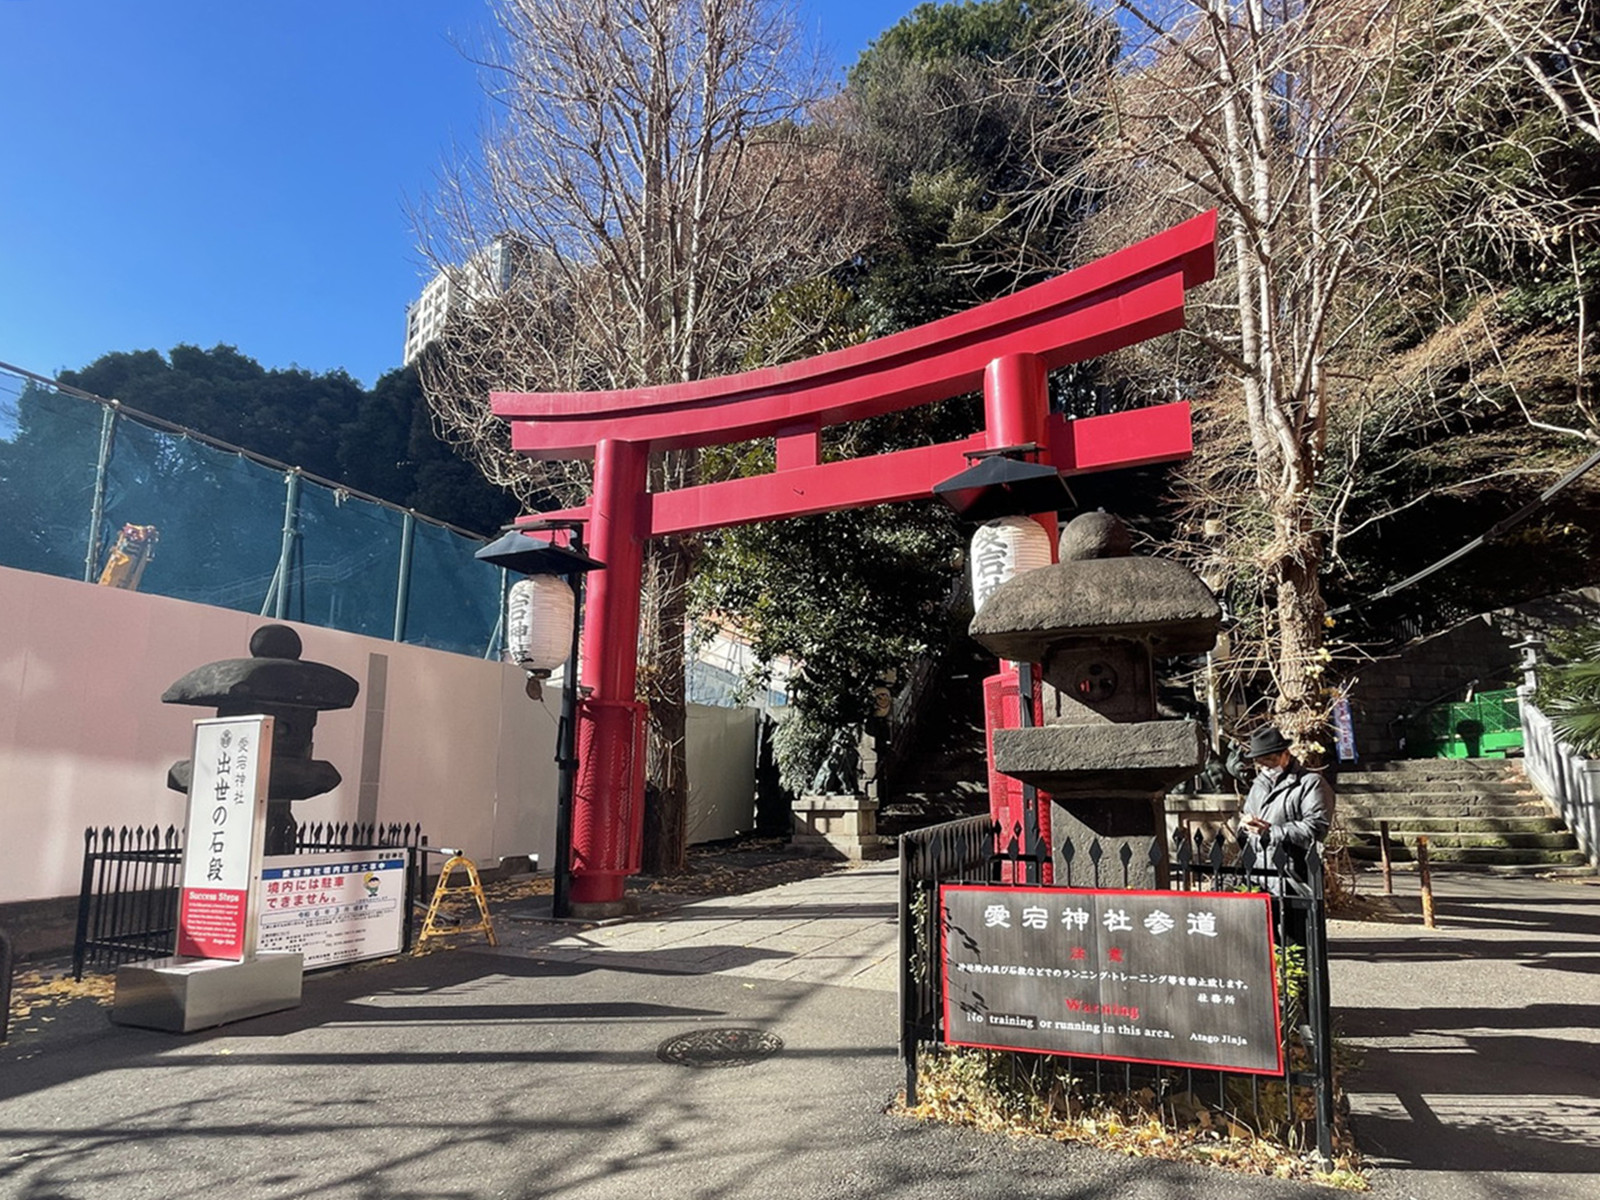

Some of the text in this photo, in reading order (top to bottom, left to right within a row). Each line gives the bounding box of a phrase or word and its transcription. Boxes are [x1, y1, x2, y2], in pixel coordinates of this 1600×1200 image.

[234, 736, 249, 805] 愛宕神社
[206, 751, 231, 882] 出世の石段
[266, 876, 345, 894] 境内には駐車
[266, 892, 337, 909] できません。
[984, 904, 1219, 938] 愛宕神社参道
[1070, 947, 1124, 963] 注意
[1197, 992, 1237, 1005] 社務所
[1065, 998, 1140, 1020] Warning
[966, 1012, 1175, 1040] No training or running in this area.
[1189, 1032, 1248, 1047] Atago Jinja
